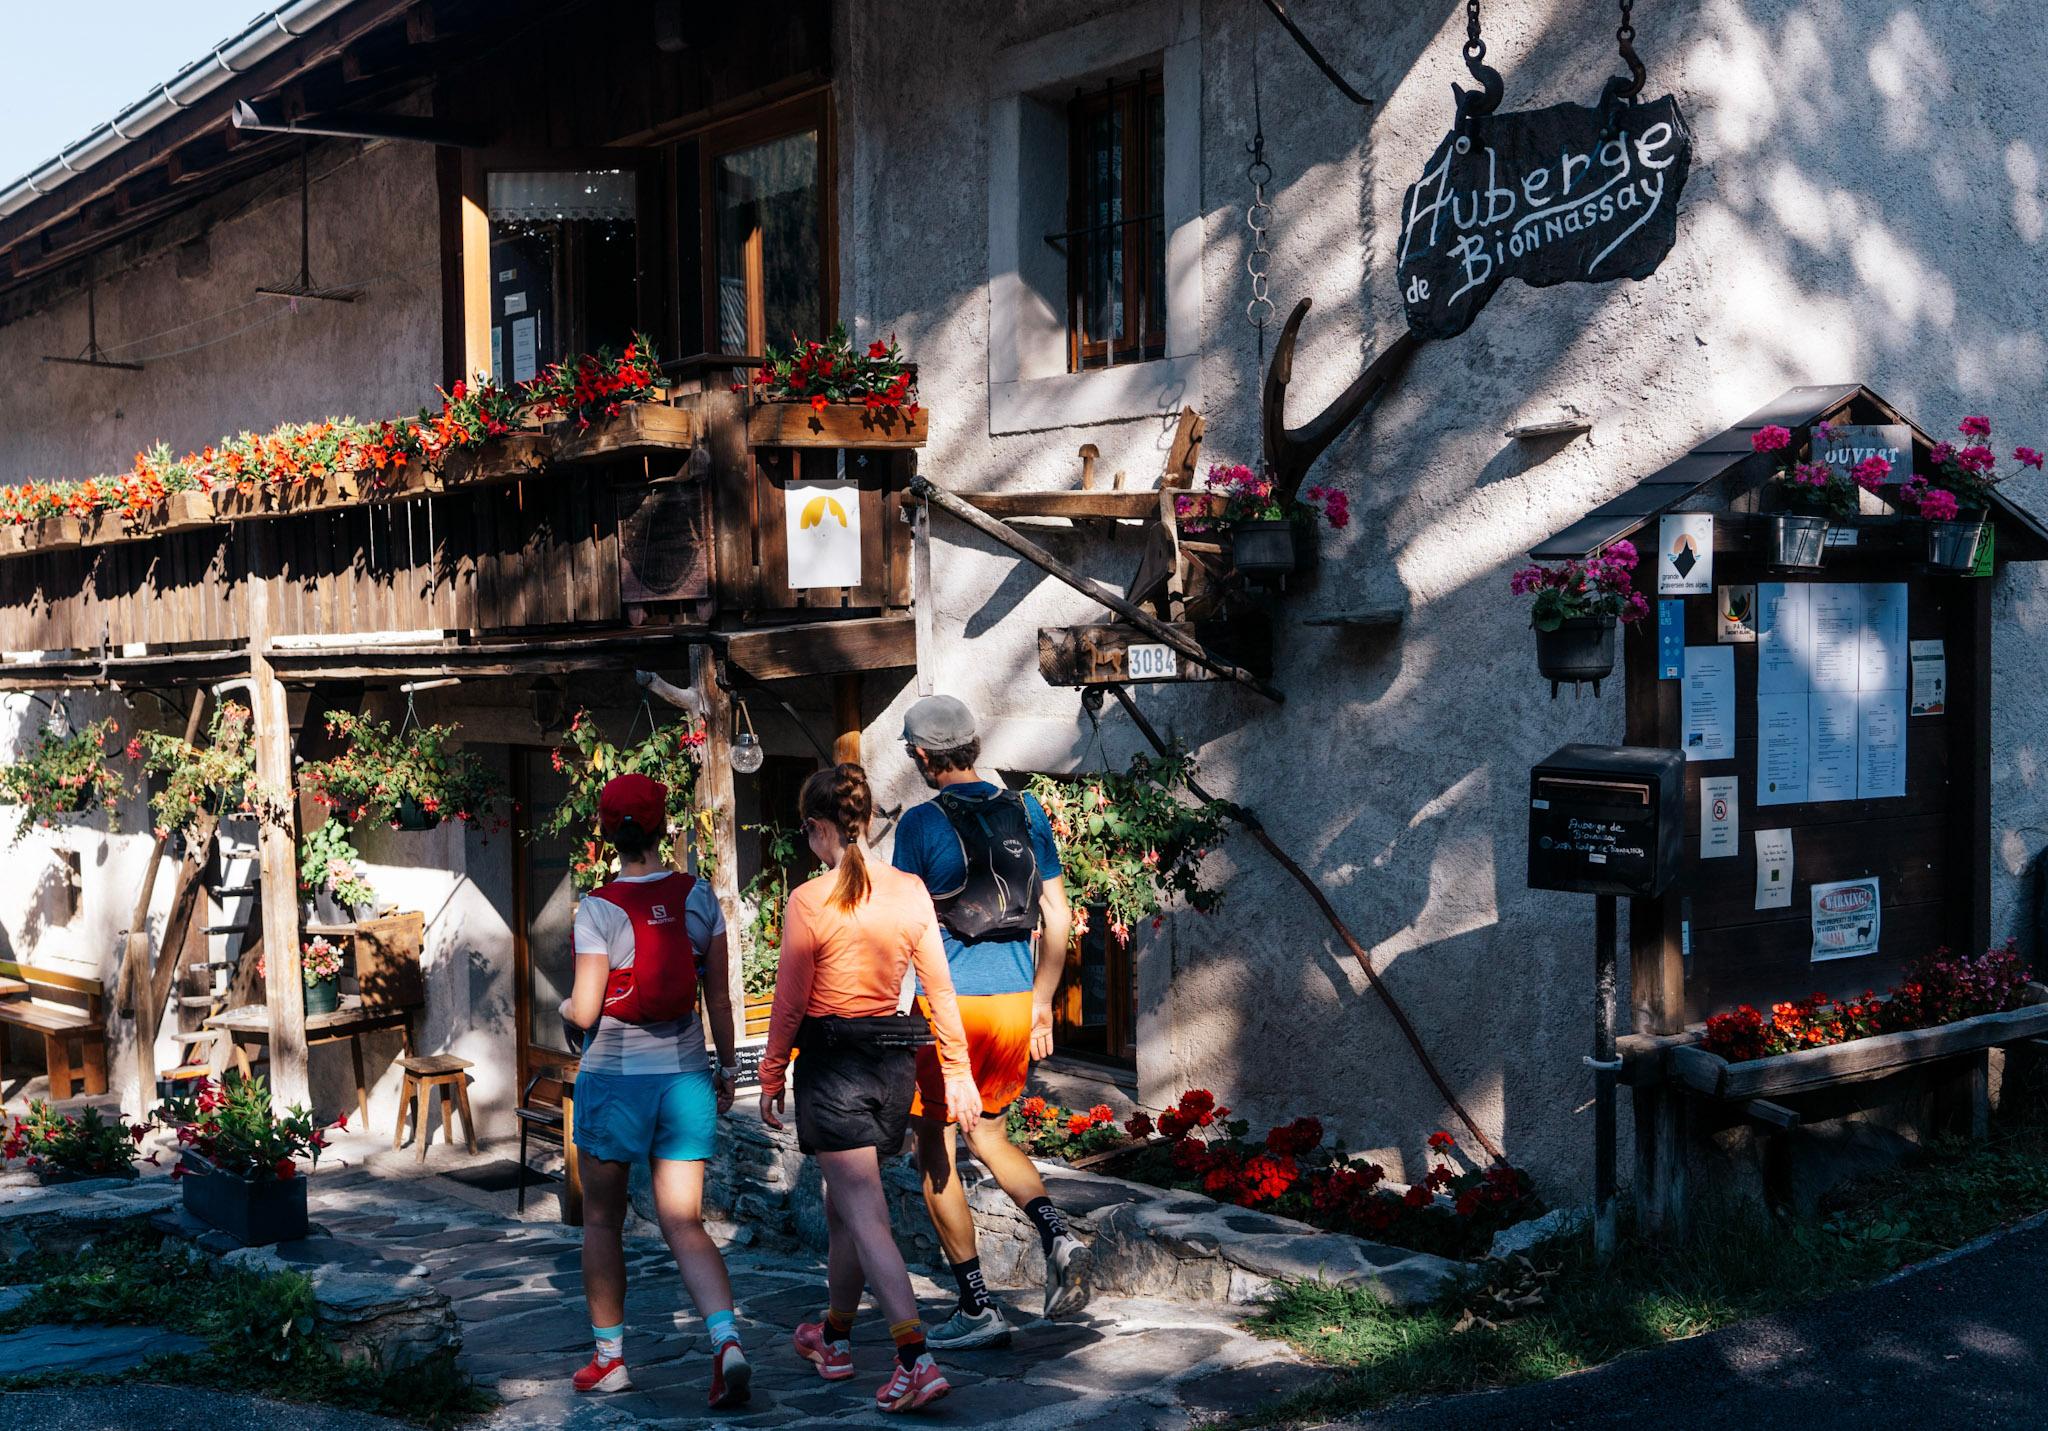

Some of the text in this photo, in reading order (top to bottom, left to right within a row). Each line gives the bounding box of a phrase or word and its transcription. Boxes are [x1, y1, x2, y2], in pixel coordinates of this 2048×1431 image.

[1400, 122, 1674, 268] Auberge
[1406, 275, 1430, 303] de
[1825, 447, 1899, 464] OUVERT
[1131, 648, 1174, 674] 3084
[1610, 821, 1626, 833] de
[1825, 892, 1867, 910] WARNING!
[966, 1268, 991, 1307] GORE
